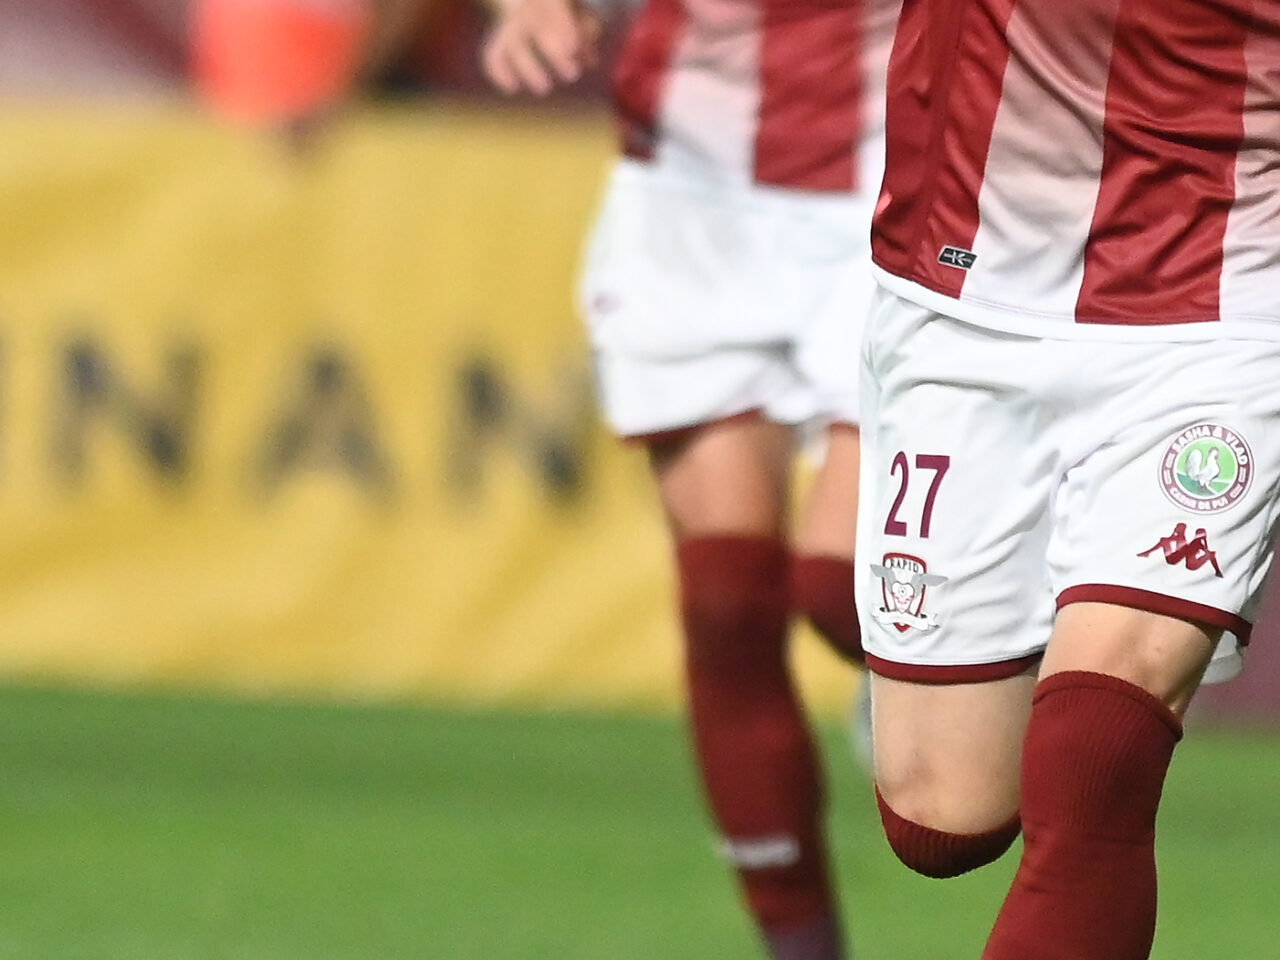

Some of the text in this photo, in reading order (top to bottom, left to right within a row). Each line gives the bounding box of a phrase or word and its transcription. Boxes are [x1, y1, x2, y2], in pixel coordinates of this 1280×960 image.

[1225, 432, 1249, 465] VLAD
[884, 451, 950, 538] 27
[890, 558, 919, 573] RAPID
